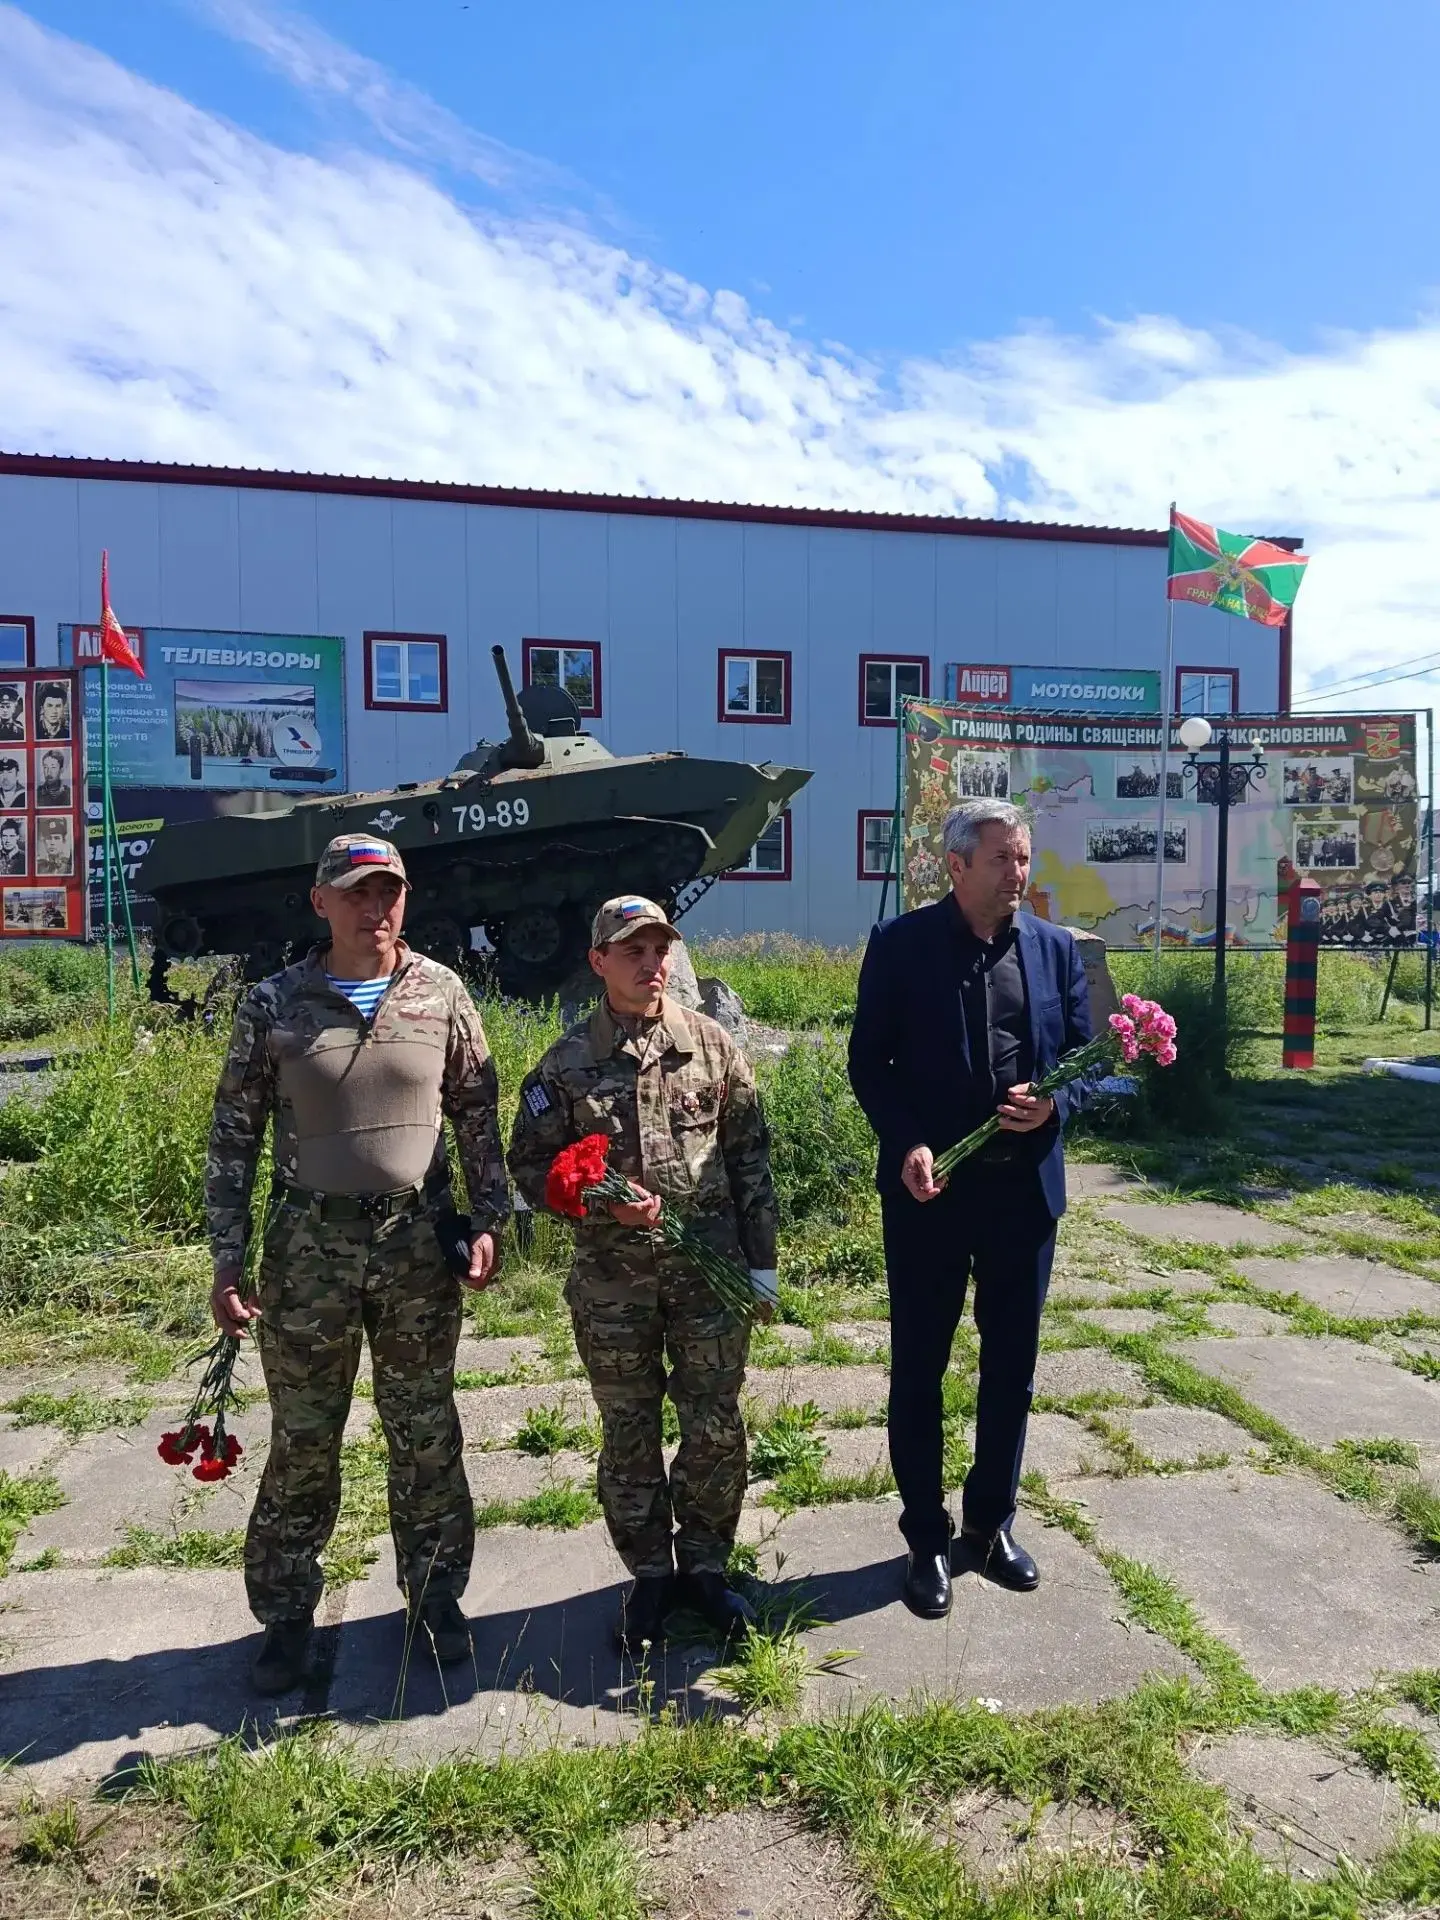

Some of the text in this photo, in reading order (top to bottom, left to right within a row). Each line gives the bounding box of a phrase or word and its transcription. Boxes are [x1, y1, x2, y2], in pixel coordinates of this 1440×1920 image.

[161, 647, 321, 669] ТЕЛЕВИЗОРЫ
[138, 683, 153, 692] ТВ
[961, 670, 1008, 698] Лидер
[1031, 684, 1145, 700] МОТОБЛОКИ
[155, 708, 169, 717] ТВ
[134, 733, 148, 741] ТВ
[951, 720, 1012, 741] ГРАНИЦА
[1016, 725, 1078, 744] РОДИНЫ
[1083, 728, 1165, 746] СВЯЩЕННА
[1209, 726, 1347, 744] РИКОСНОВЕННА
[452, 798, 529, 833] 79-89
